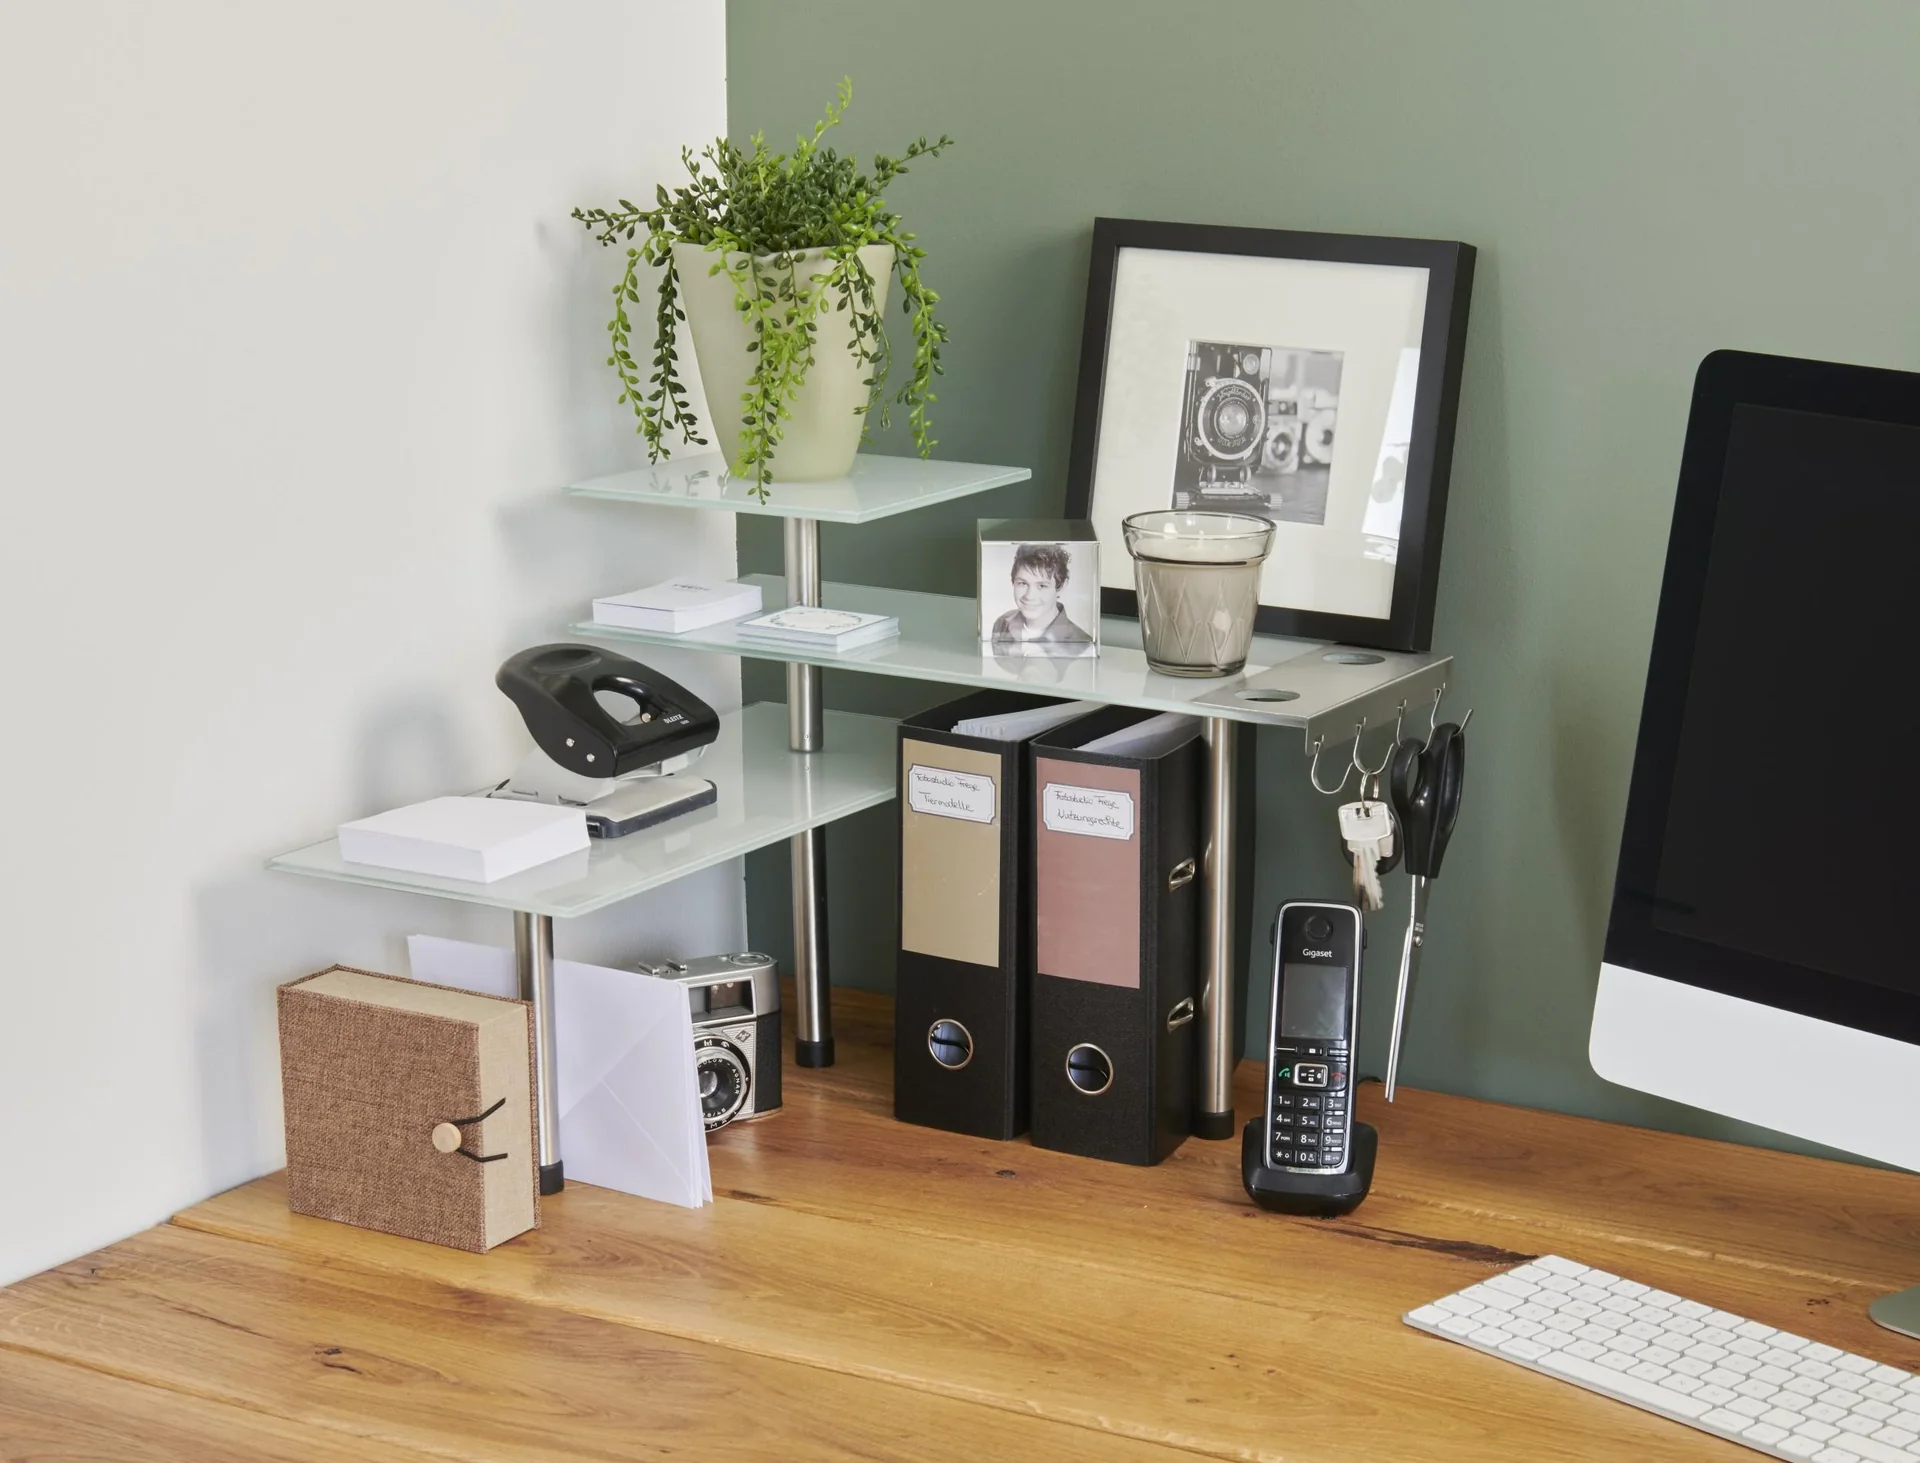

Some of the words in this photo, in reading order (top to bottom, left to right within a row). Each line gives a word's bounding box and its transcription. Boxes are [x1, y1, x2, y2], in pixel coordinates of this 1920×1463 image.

[1302, 948, 1333, 959] Gigaset
[1278, 1095, 1283, 1105] 1
[1302, 1097, 1309, 1107] 2
[1327, 1099, 1334, 1108] 3
[1276, 1113, 1283, 1123] 4
[1301, 1116, 1308, 1125] 5
[1326, 1117, 1333, 1126] 6
[1275, 1131, 1282, 1141] 7
[1300, 1134, 1307, 1144] 8
[1325, 1135, 1332, 1145] 9
[1300, 1152, 1307, 1162] 0
